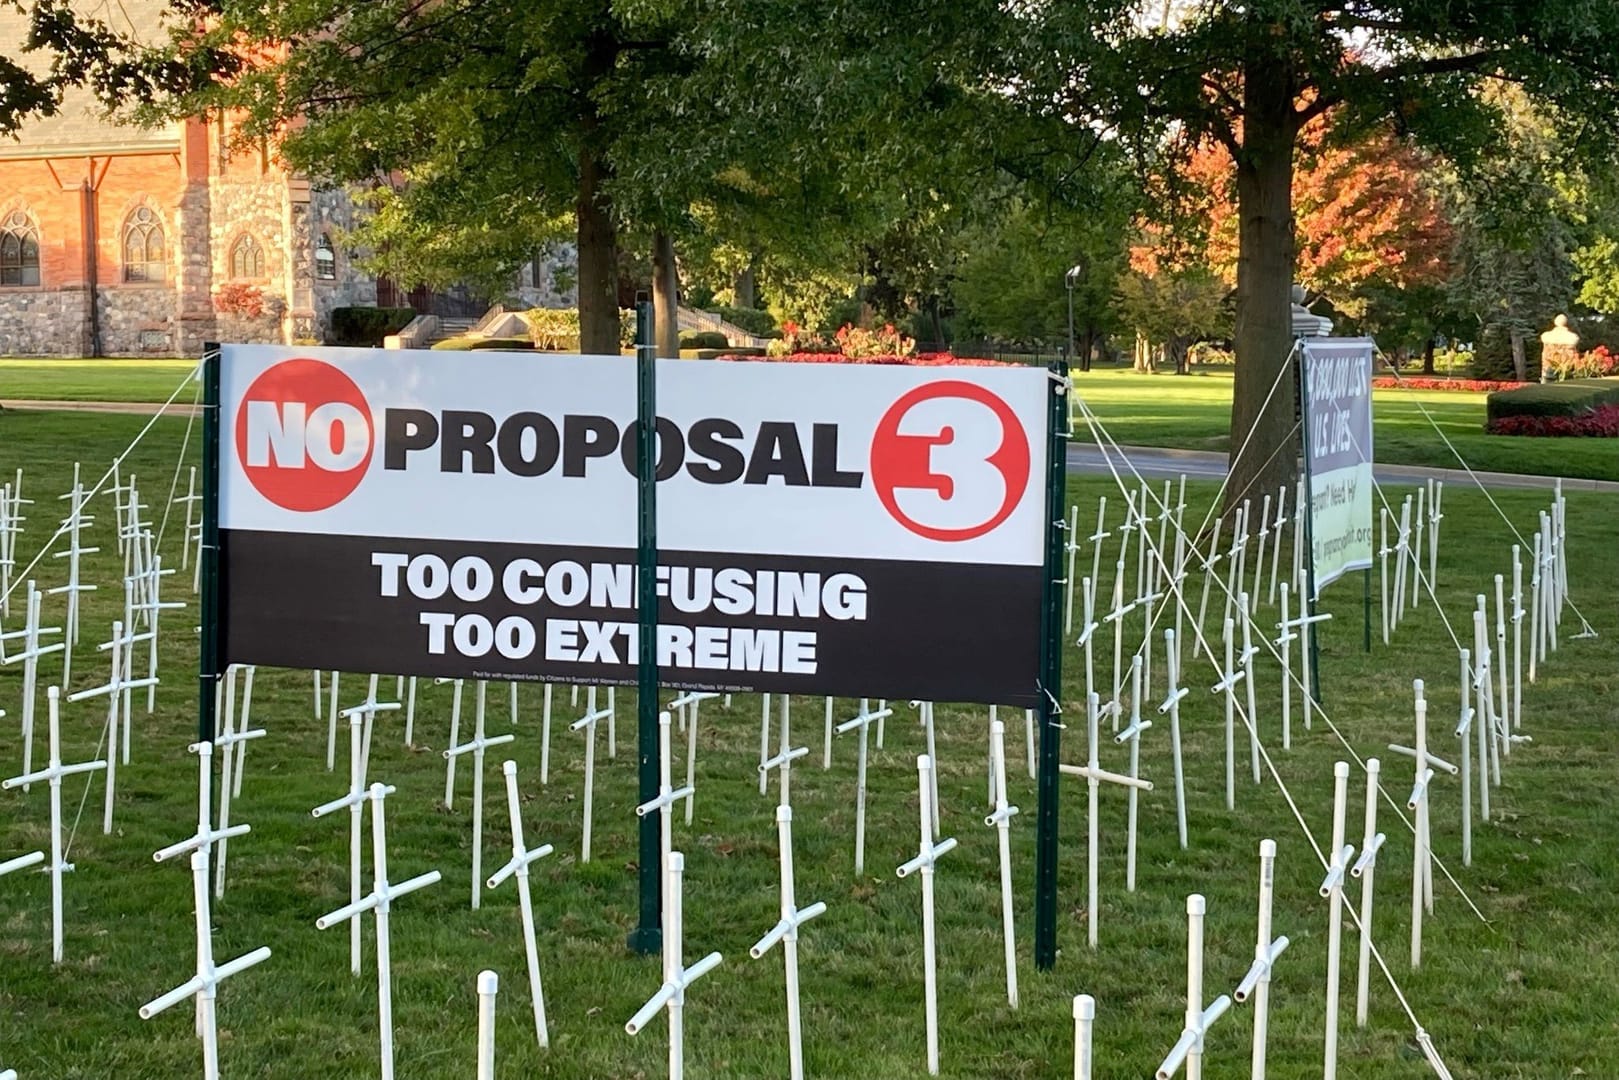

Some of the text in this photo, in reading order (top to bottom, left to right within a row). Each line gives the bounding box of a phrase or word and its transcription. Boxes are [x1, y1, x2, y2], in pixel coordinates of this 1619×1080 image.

[246, 396, 1008, 531] NO PROPOSAL 3
[371, 552, 494, 602] TOO
[419, 612, 818, 674] TOO EXTREME
[572, 676, 591, 684] Support
